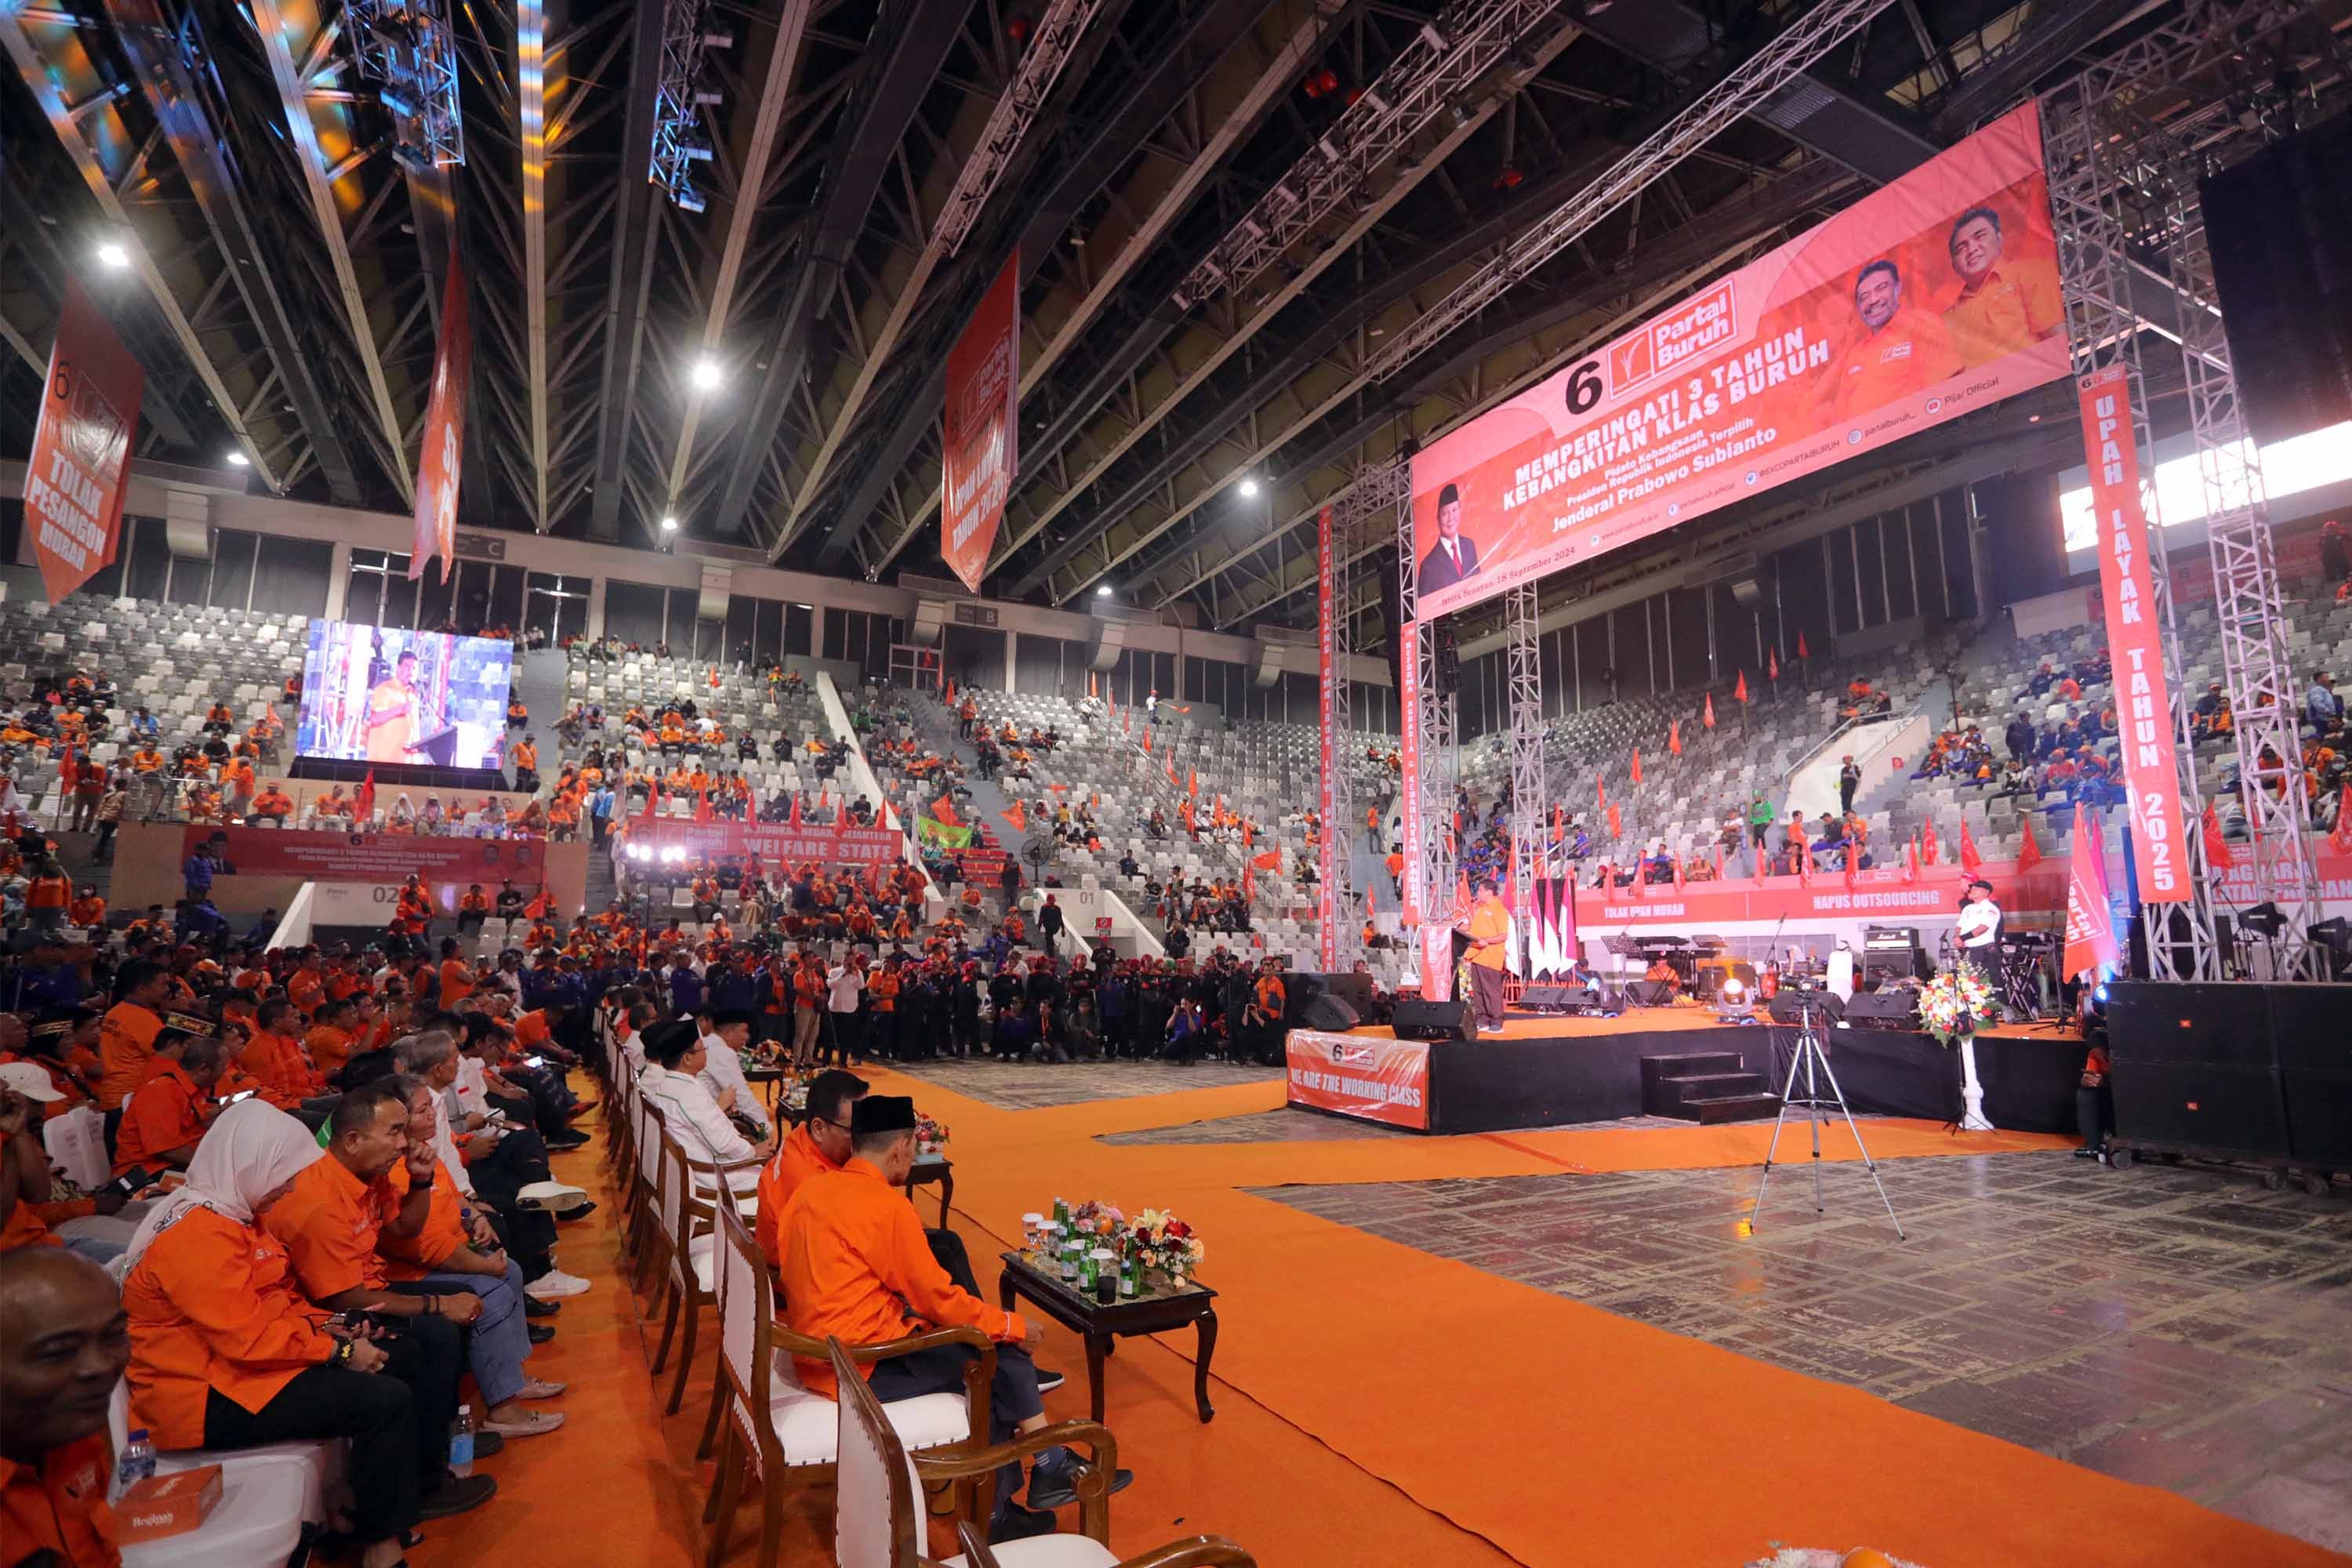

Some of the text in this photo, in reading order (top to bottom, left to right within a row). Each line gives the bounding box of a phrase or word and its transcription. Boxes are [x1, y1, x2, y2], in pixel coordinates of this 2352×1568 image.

[1655, 292, 1727, 347] Partai
[1657, 315, 1730, 368] Buruh
[55, 361, 69, 400] 6
[1566, 361, 1603, 415] 6
[1944, 377, 1999, 406] Pijar Official
[2082, 379, 2092, 388] 6
[1503, 339, 1829, 511] KEBANGKITAN KLAS BURUH
[1515, 327, 1803, 485] MEMPERINGATI 3 TAHUN
[1567, 417, 1754, 507] Presiden Republik Indonesia Terpilih
[1605, 430, 1704, 480] Pidato Kebangsaan
[51, 449, 104, 519] TOLAK
[1552, 427, 1777, 533] Jenderal Prabowo Subianto
[28, 474, 107, 557] PESANGON
[39, 520, 88, 572] MURAH
[488, 541, 501, 556] C
[1497, 573, 1508, 584] 18
[1509, 557, 1551, 579] September
[1554, 546, 1575, 561] 2024
[986, 610, 995, 622] B
[2095, 395, 2123, 486] UPAH
[2112, 509, 2142, 624] LAYAK
[2127, 648, 2159, 767] TAHUN
[2144, 793, 2175, 891] 2025
[350, 834, 362, 846] 6
[742, 838, 891, 860] WELFARE STATE
[372, 886, 399, 904] 02
[1080, 891, 1094, 904] 01
[1604, 906, 1629, 919] TOLAK
[1813, 890, 1940, 909] HAPUS OUTSOURCING
[1333, 1044, 1342, 1062] 6
[1290, 1068, 1421, 1109] WE ARE THE WORKING CLASS
